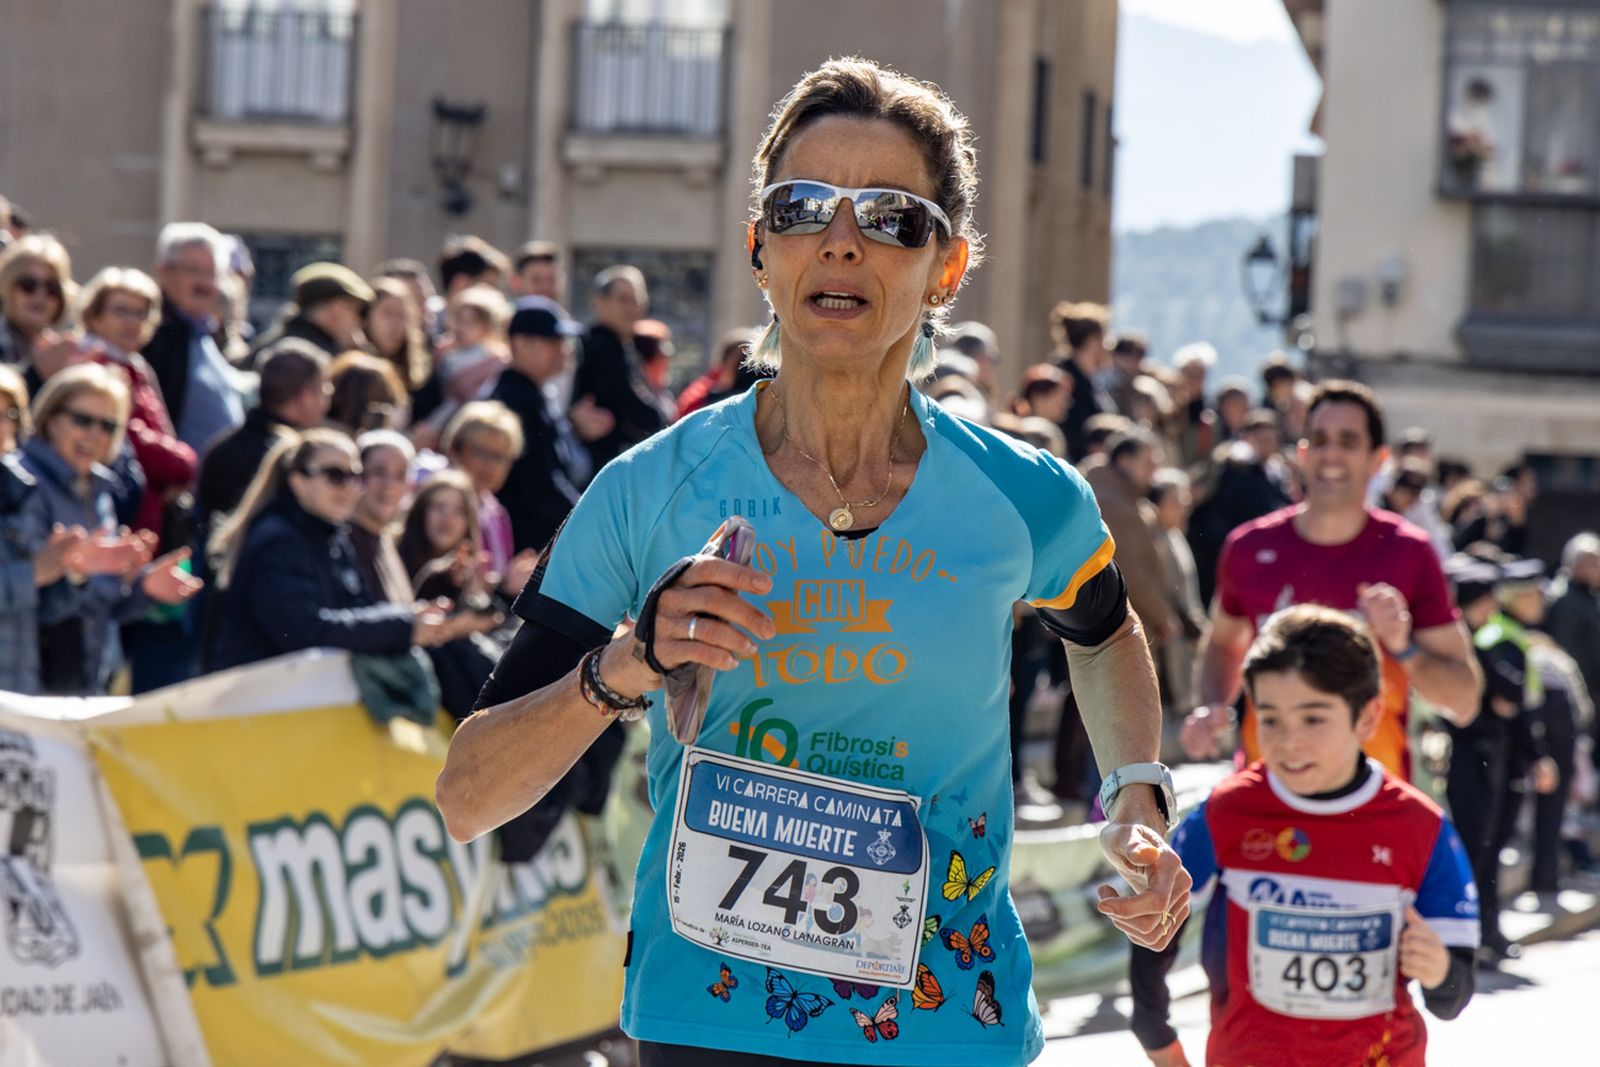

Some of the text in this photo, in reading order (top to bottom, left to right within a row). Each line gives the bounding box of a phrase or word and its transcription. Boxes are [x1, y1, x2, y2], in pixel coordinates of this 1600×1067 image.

[719, 496, 782, 518] GOBIK
[755, 536, 798, 577] OY
[798, 581, 863, 621] CON
[740, 641, 913, 688] TODO
[809, 731, 909, 758] Fibrosis
[806, 753, 905, 782] Quística
[716, 773, 902, 827] VI CARRERA CAMINATA
[708, 800, 858, 857] BUENA MUERTE
[717, 844, 860, 935] 743
[714, 912, 745, 929] MARÍA
[747, 921, 791, 938] LOZANO
[793, 930, 855, 950] LANAGRAN
[1282, 956, 1368, 993] 403
